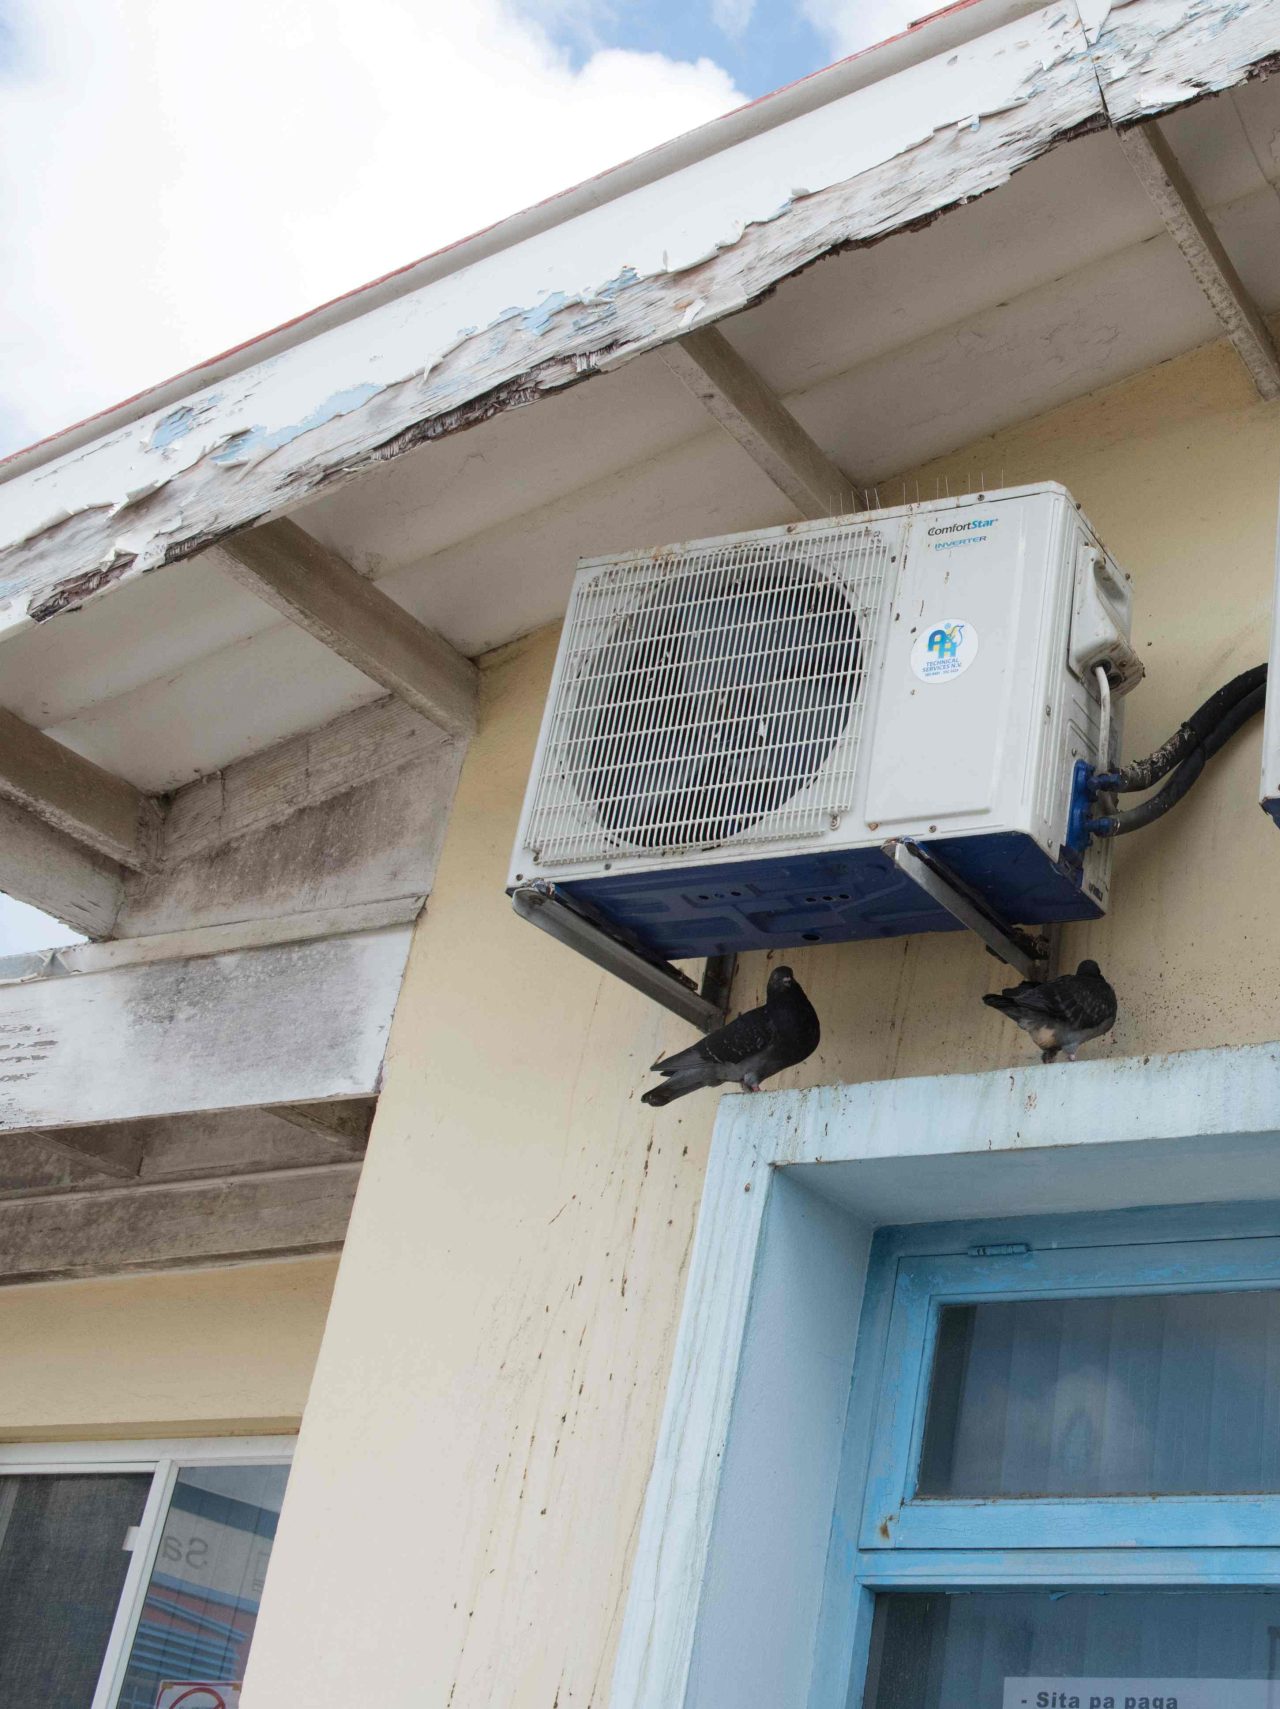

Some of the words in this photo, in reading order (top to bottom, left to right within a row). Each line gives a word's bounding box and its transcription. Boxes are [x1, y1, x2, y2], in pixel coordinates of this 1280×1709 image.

[927, 518, 996, 537] ComfortStar
[934, 535, 988, 550] INVERTER
[922, 664, 950, 673] SERVICES
[926, 657, 960, 667] TECHNICAL
[1036, 1691, 1081, 1709] Sita
[1089, 1696, 1115, 1709] pa
